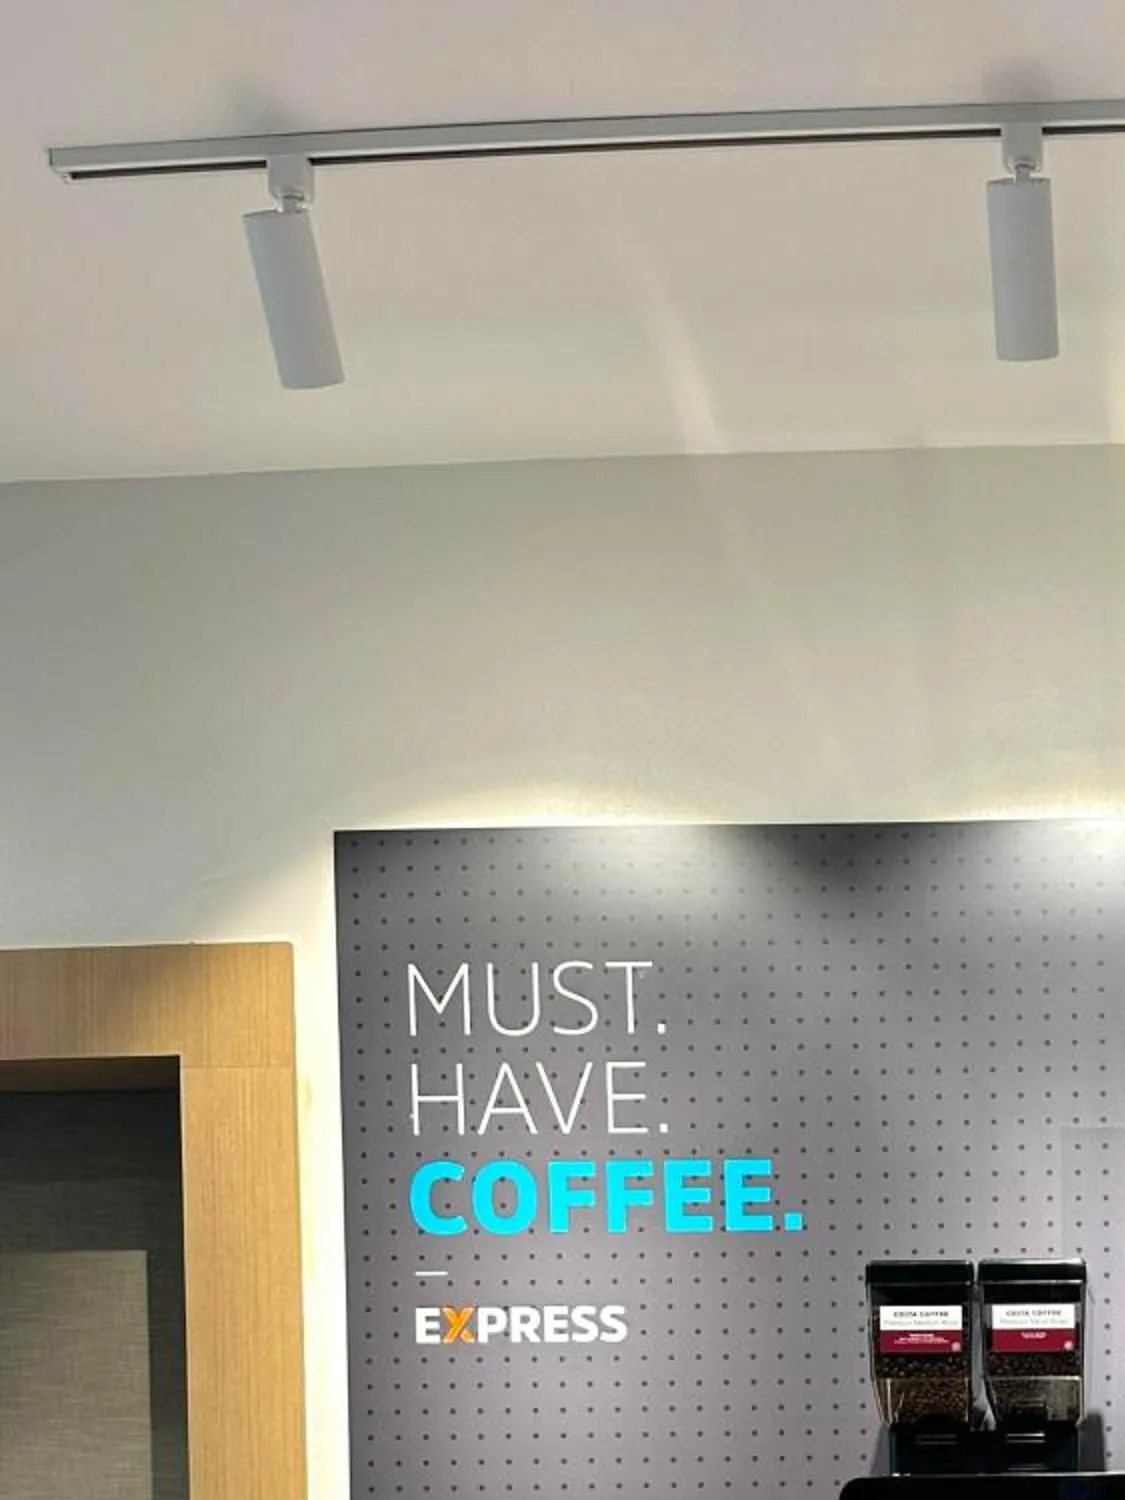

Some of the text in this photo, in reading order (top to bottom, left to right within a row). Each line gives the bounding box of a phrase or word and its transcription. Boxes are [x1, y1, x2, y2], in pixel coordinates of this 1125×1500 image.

[407, 960, 667, 1037] MUST.
[410, 1061, 669, 1136] HAVE.
[409, 1157, 804, 1236] COFFEE.
[415, 1305, 628, 1344] EXPRESS
